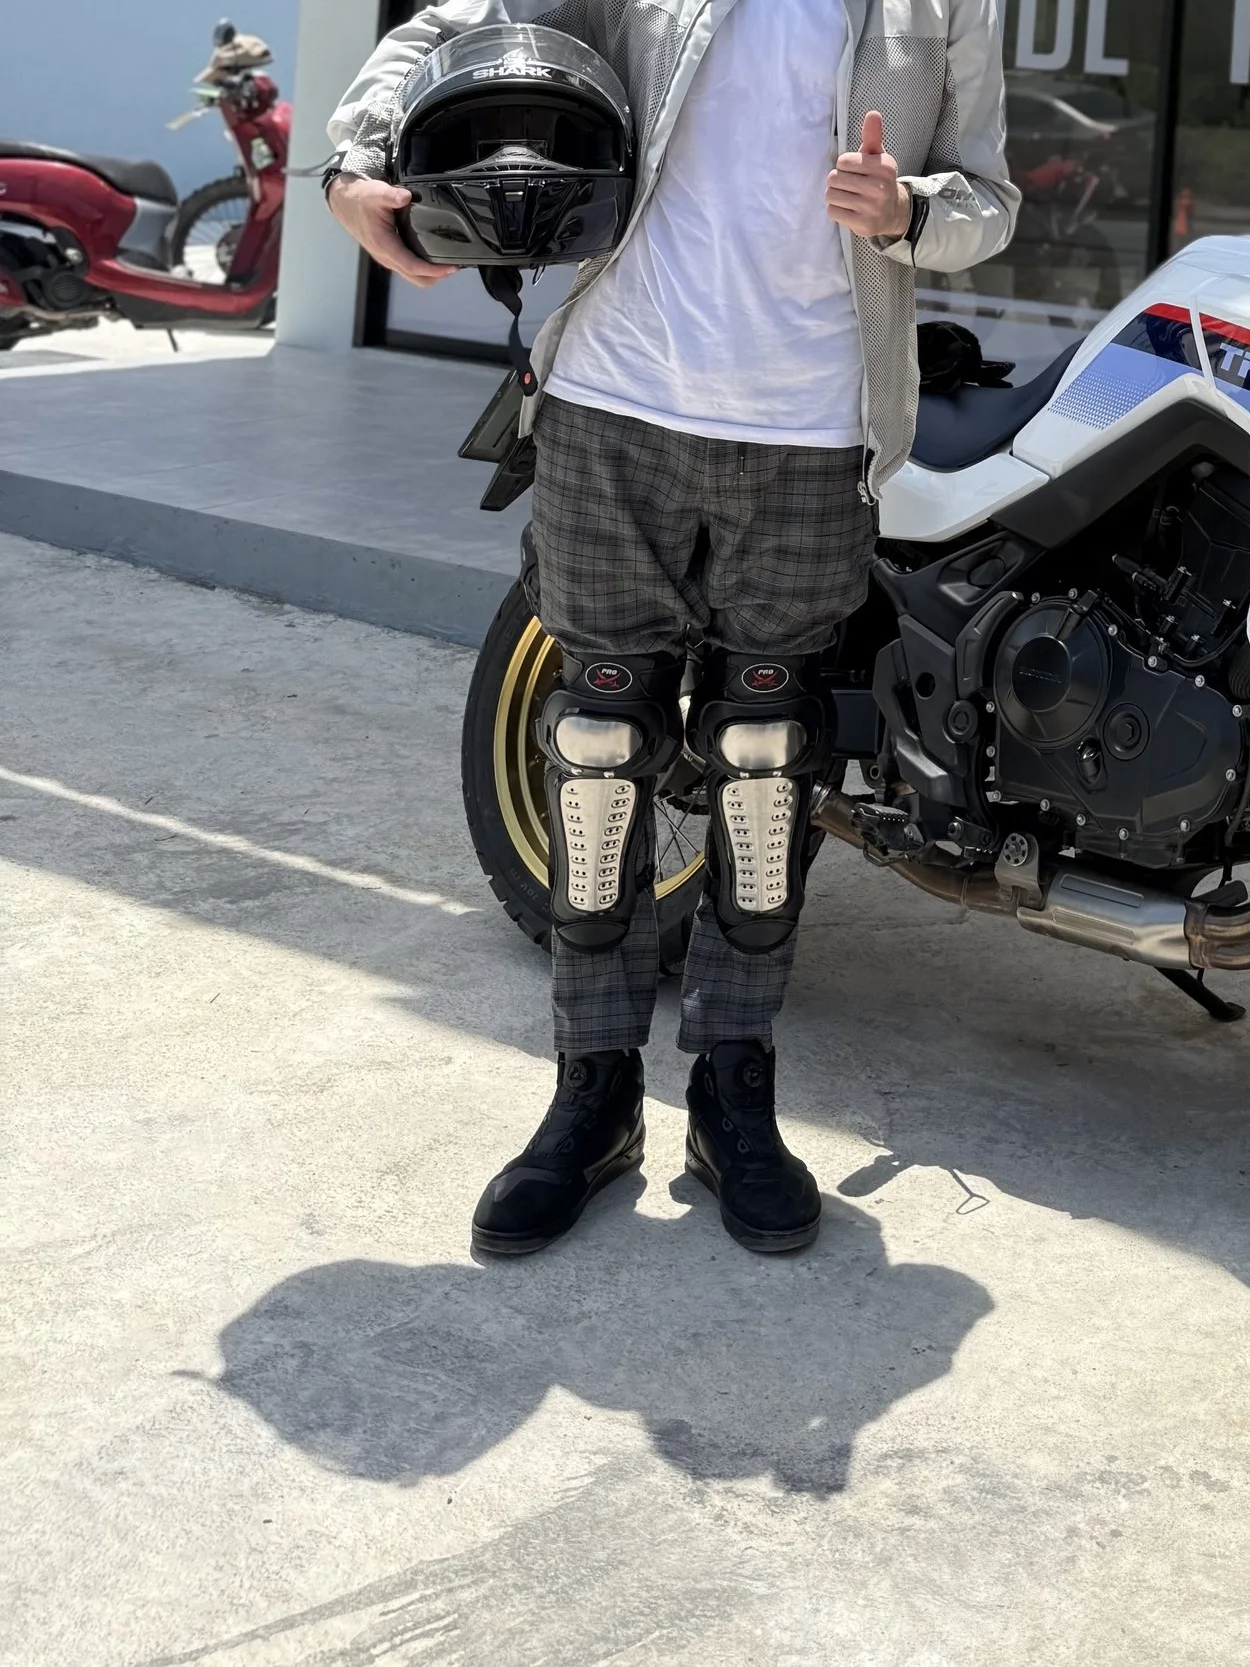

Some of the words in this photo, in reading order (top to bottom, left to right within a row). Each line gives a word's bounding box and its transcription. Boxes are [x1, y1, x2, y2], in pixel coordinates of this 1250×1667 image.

[472, 66, 552, 80] SHARK
[601, 667, 618, 676] PRO
[758, 668, 774, 676] PRO
